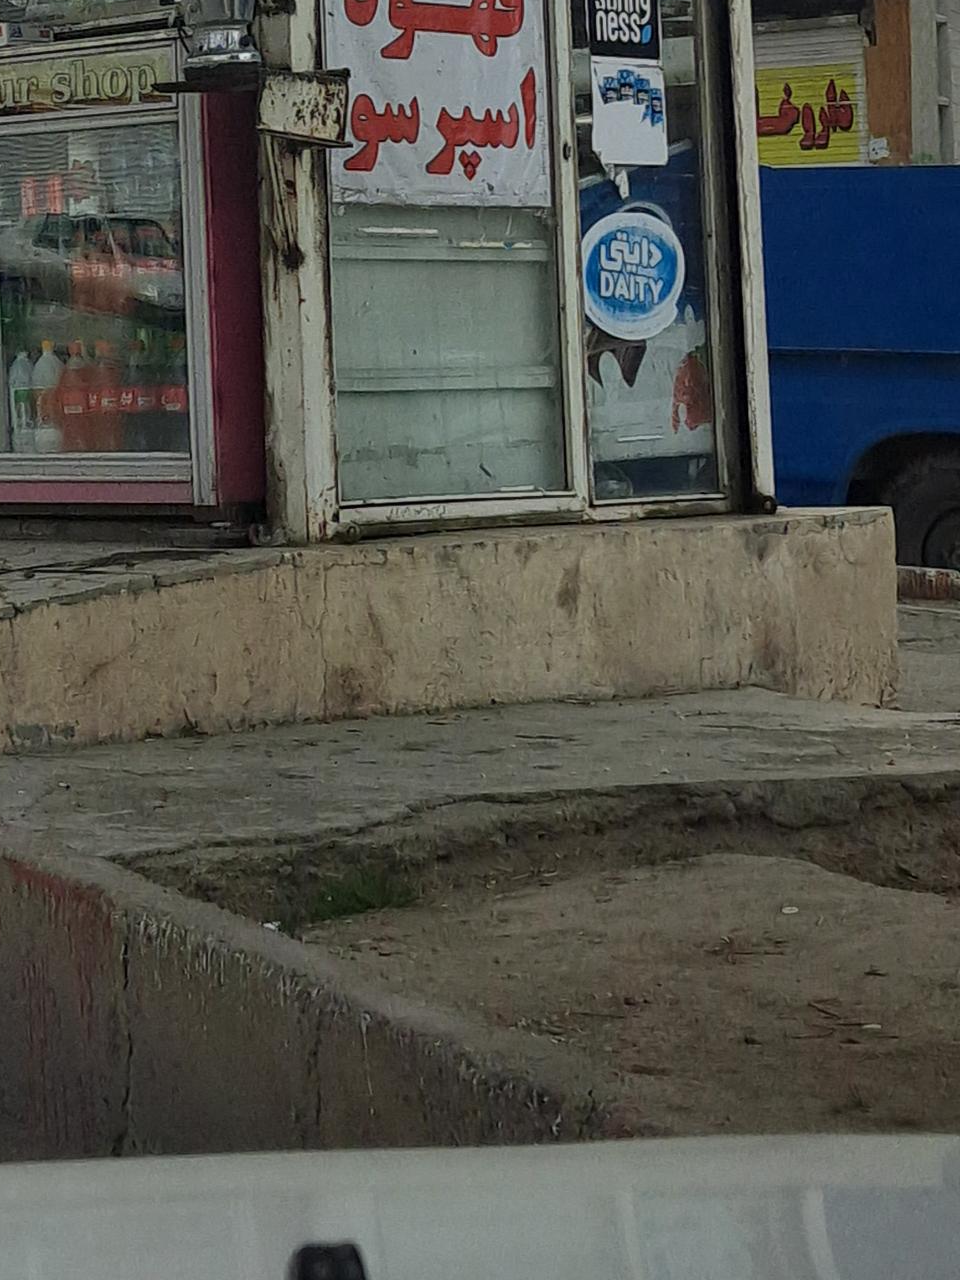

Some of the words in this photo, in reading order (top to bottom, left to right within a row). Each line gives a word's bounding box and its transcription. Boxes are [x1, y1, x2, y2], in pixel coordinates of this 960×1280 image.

[595, 10, 641, 44] ness
[50, 59, 158, 105] shop
[343, 66, 537, 181] اسپرسو
[599, 270, 665, 304] DAITY
